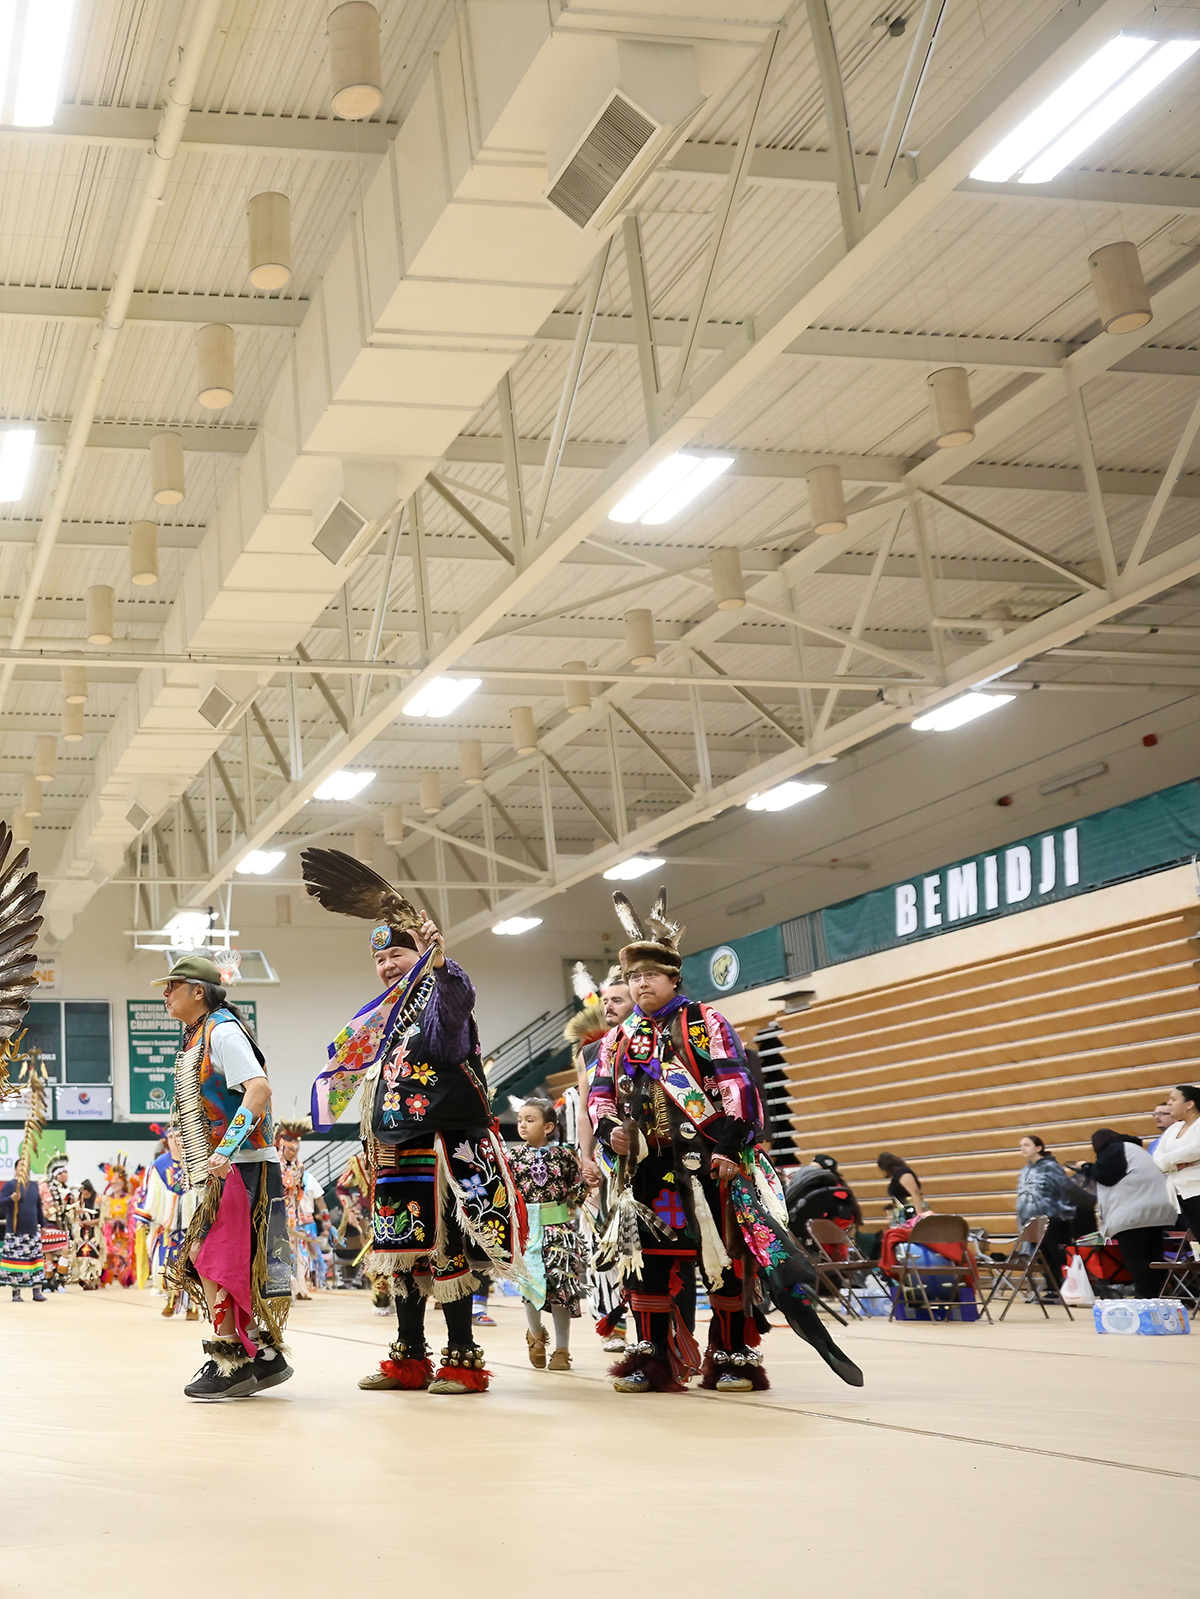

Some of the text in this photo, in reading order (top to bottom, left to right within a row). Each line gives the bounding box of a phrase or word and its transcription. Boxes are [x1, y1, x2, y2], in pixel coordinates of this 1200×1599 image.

[895, 827, 1080, 937] BEMIDJI
[130, 1020, 181, 1030] CHAMPIONS
[145, 1101, 170, 1110] BSU
